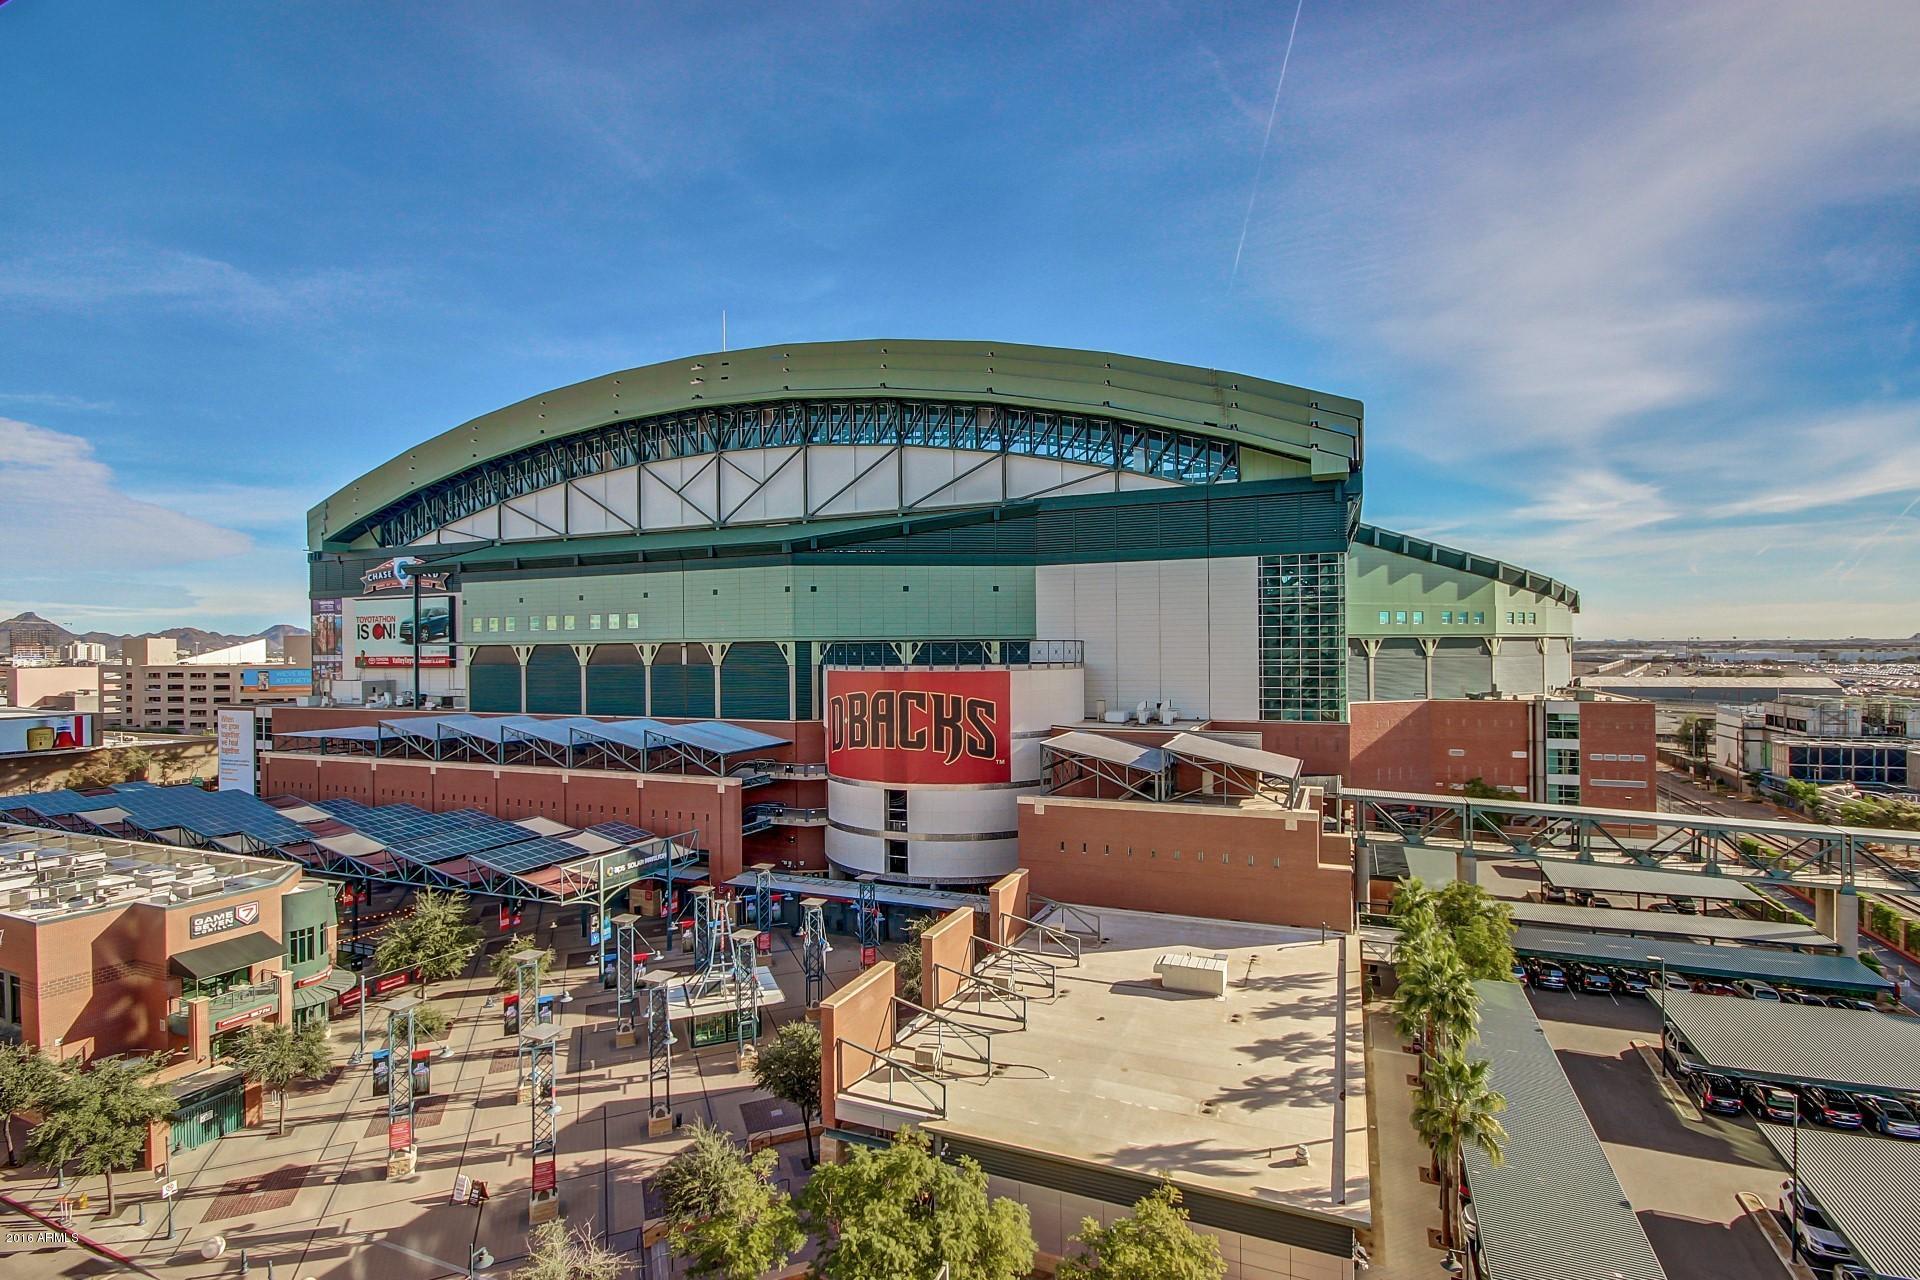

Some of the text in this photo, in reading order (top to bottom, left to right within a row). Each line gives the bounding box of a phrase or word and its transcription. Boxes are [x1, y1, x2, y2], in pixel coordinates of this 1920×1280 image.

[367, 570, 392, 582] CHASE
[356, 615, 396, 623] TOYOTATHON
[357, 623, 396, 640] IS ON!
[194, 911, 233, 926] GAME
[194, 917, 233, 932] SEVEN
